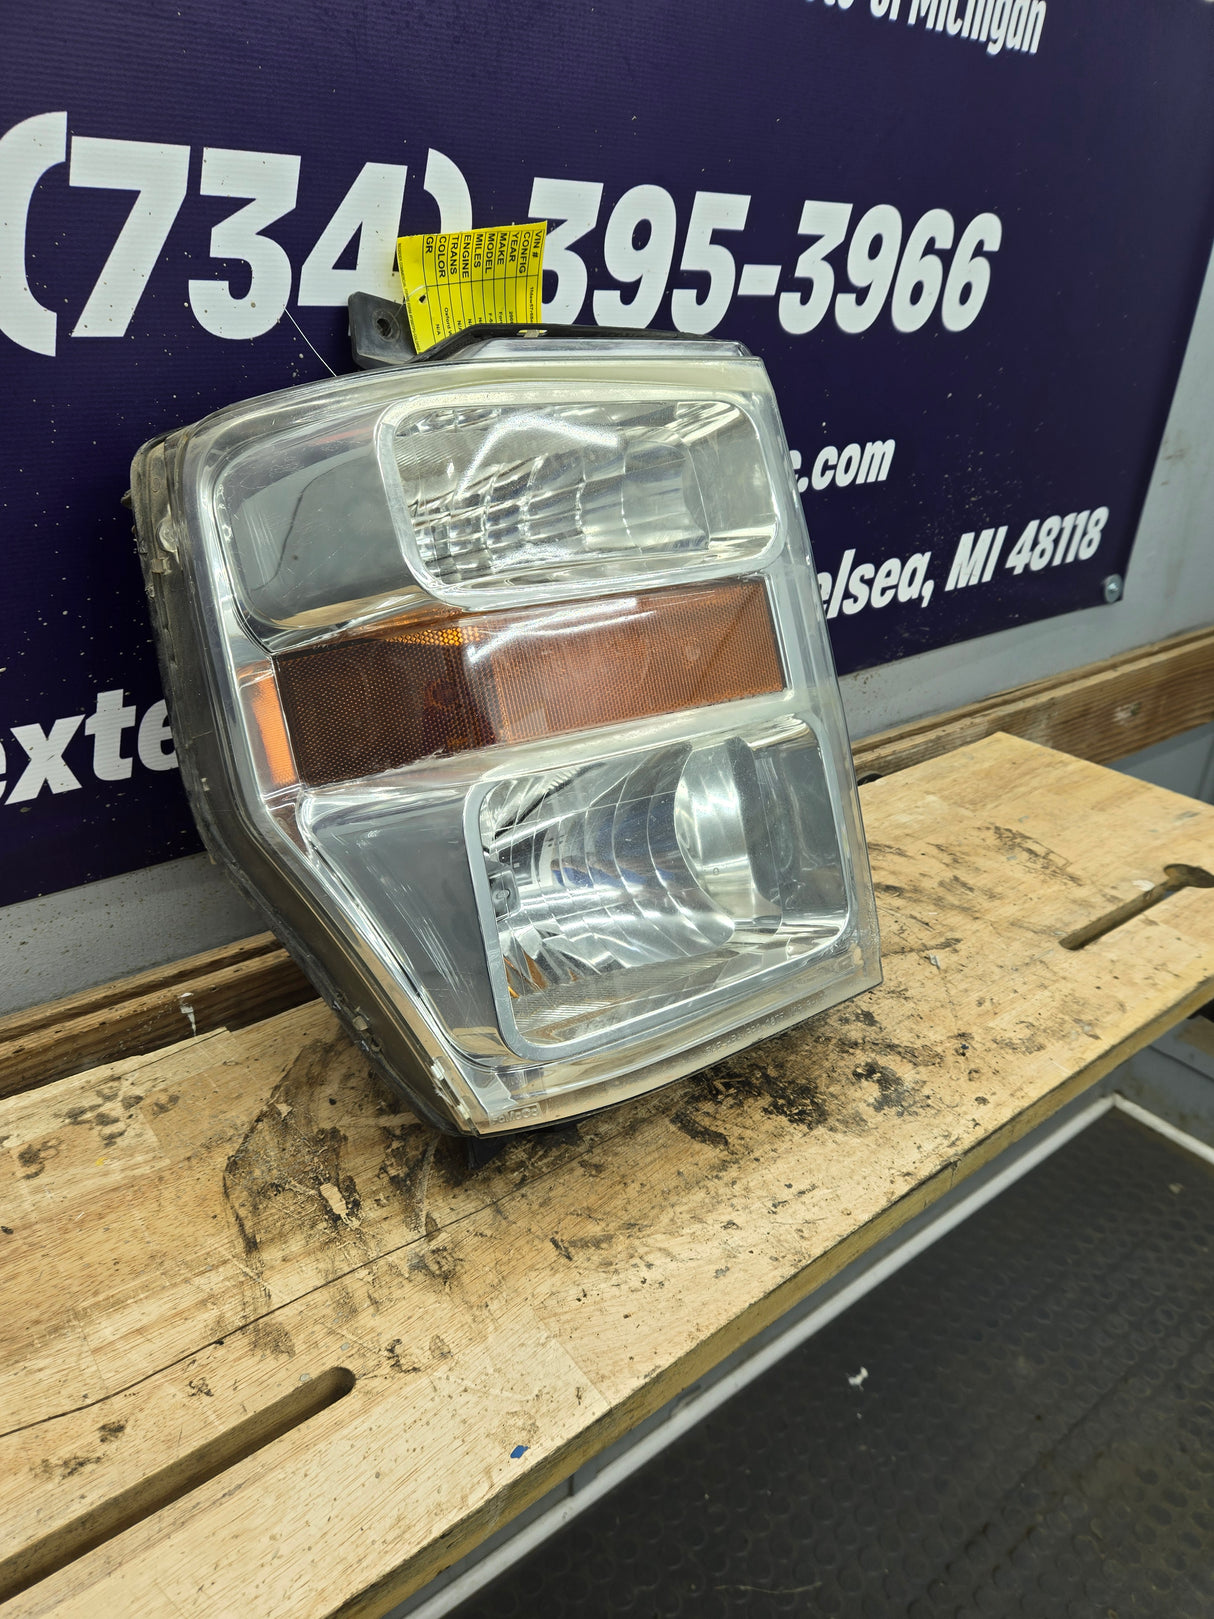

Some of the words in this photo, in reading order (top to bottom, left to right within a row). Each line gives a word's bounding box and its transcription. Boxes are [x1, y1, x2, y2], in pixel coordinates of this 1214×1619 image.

[426, 236, 435, 254] GR
[450, 234, 459, 275] TRANS
[462, 234, 472, 279] ENGINE
[473, 233, 484, 268] MILES
[485, 233, 495, 274] MODEL
[496, 232, 508, 265] MAKE
[509, 231, 520, 264] YEAR
[519, 231, 531, 274] CONFIG
[526, 177, 1002, 336] 395-3966
[532, 250, 539, 258] #
[533, 230, 543, 249] VIN
[437, 235, 448, 278] COLOR
[444, 307, 452, 329] Oxford
[945, 526, 1008, 591] MI
[1005, 506, 1109, 575] 48118
[0, 689, 179, 806] xte
